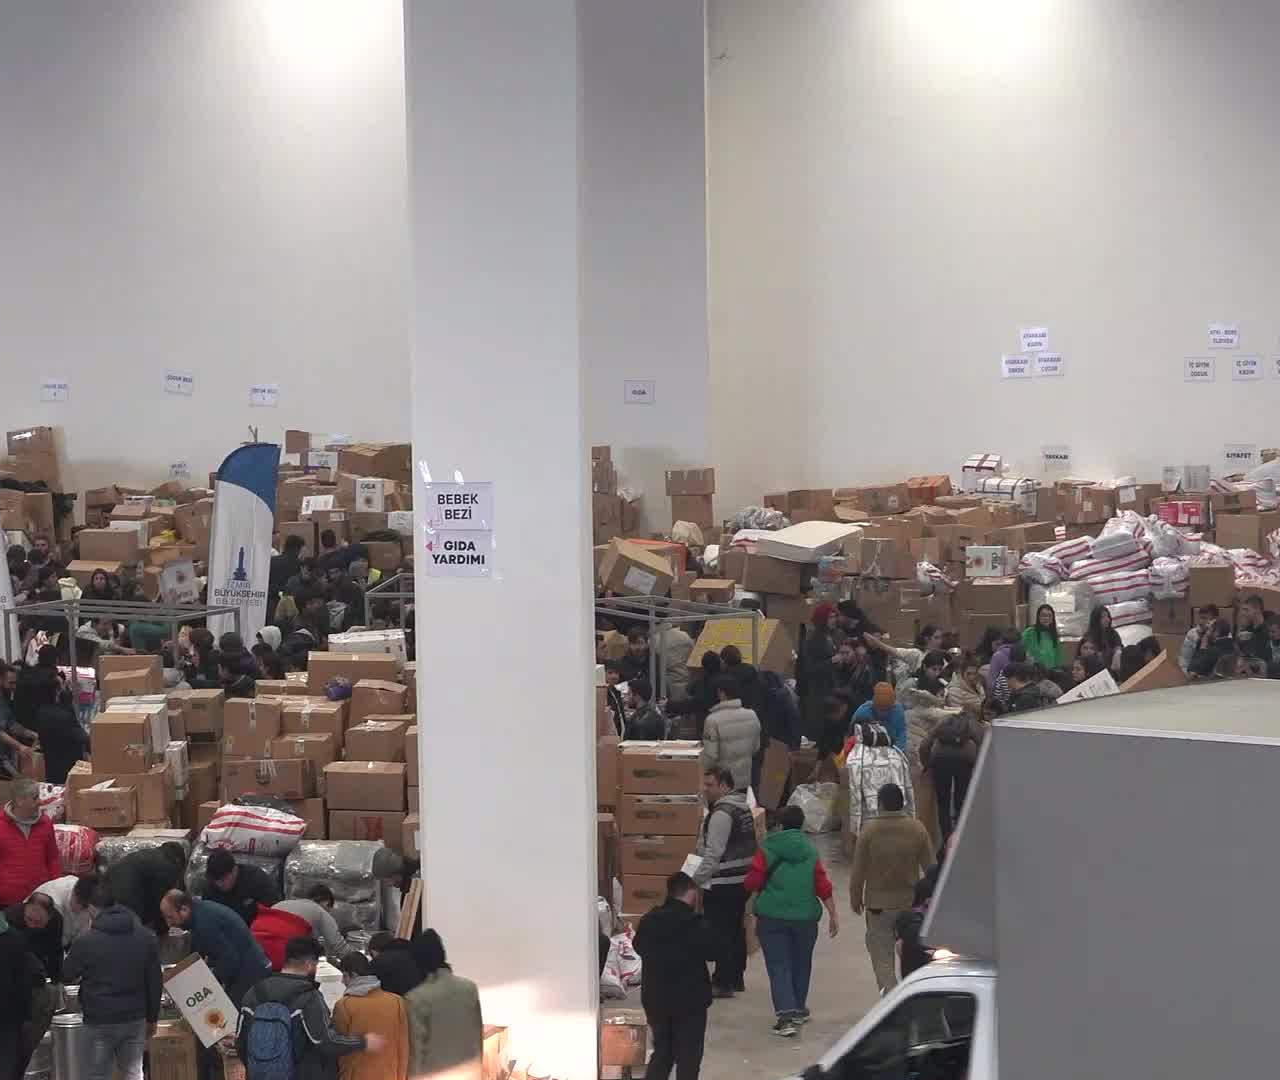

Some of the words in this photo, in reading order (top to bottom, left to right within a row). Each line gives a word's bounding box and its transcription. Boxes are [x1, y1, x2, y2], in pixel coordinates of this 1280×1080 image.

[437, 493, 479, 505] BEBEK
[444, 506, 472, 520] BEZİ
[444, 540, 476, 552] GIDA
[432, 554, 485, 565] YARDIMI
[185, 986, 214, 1007] OBA
